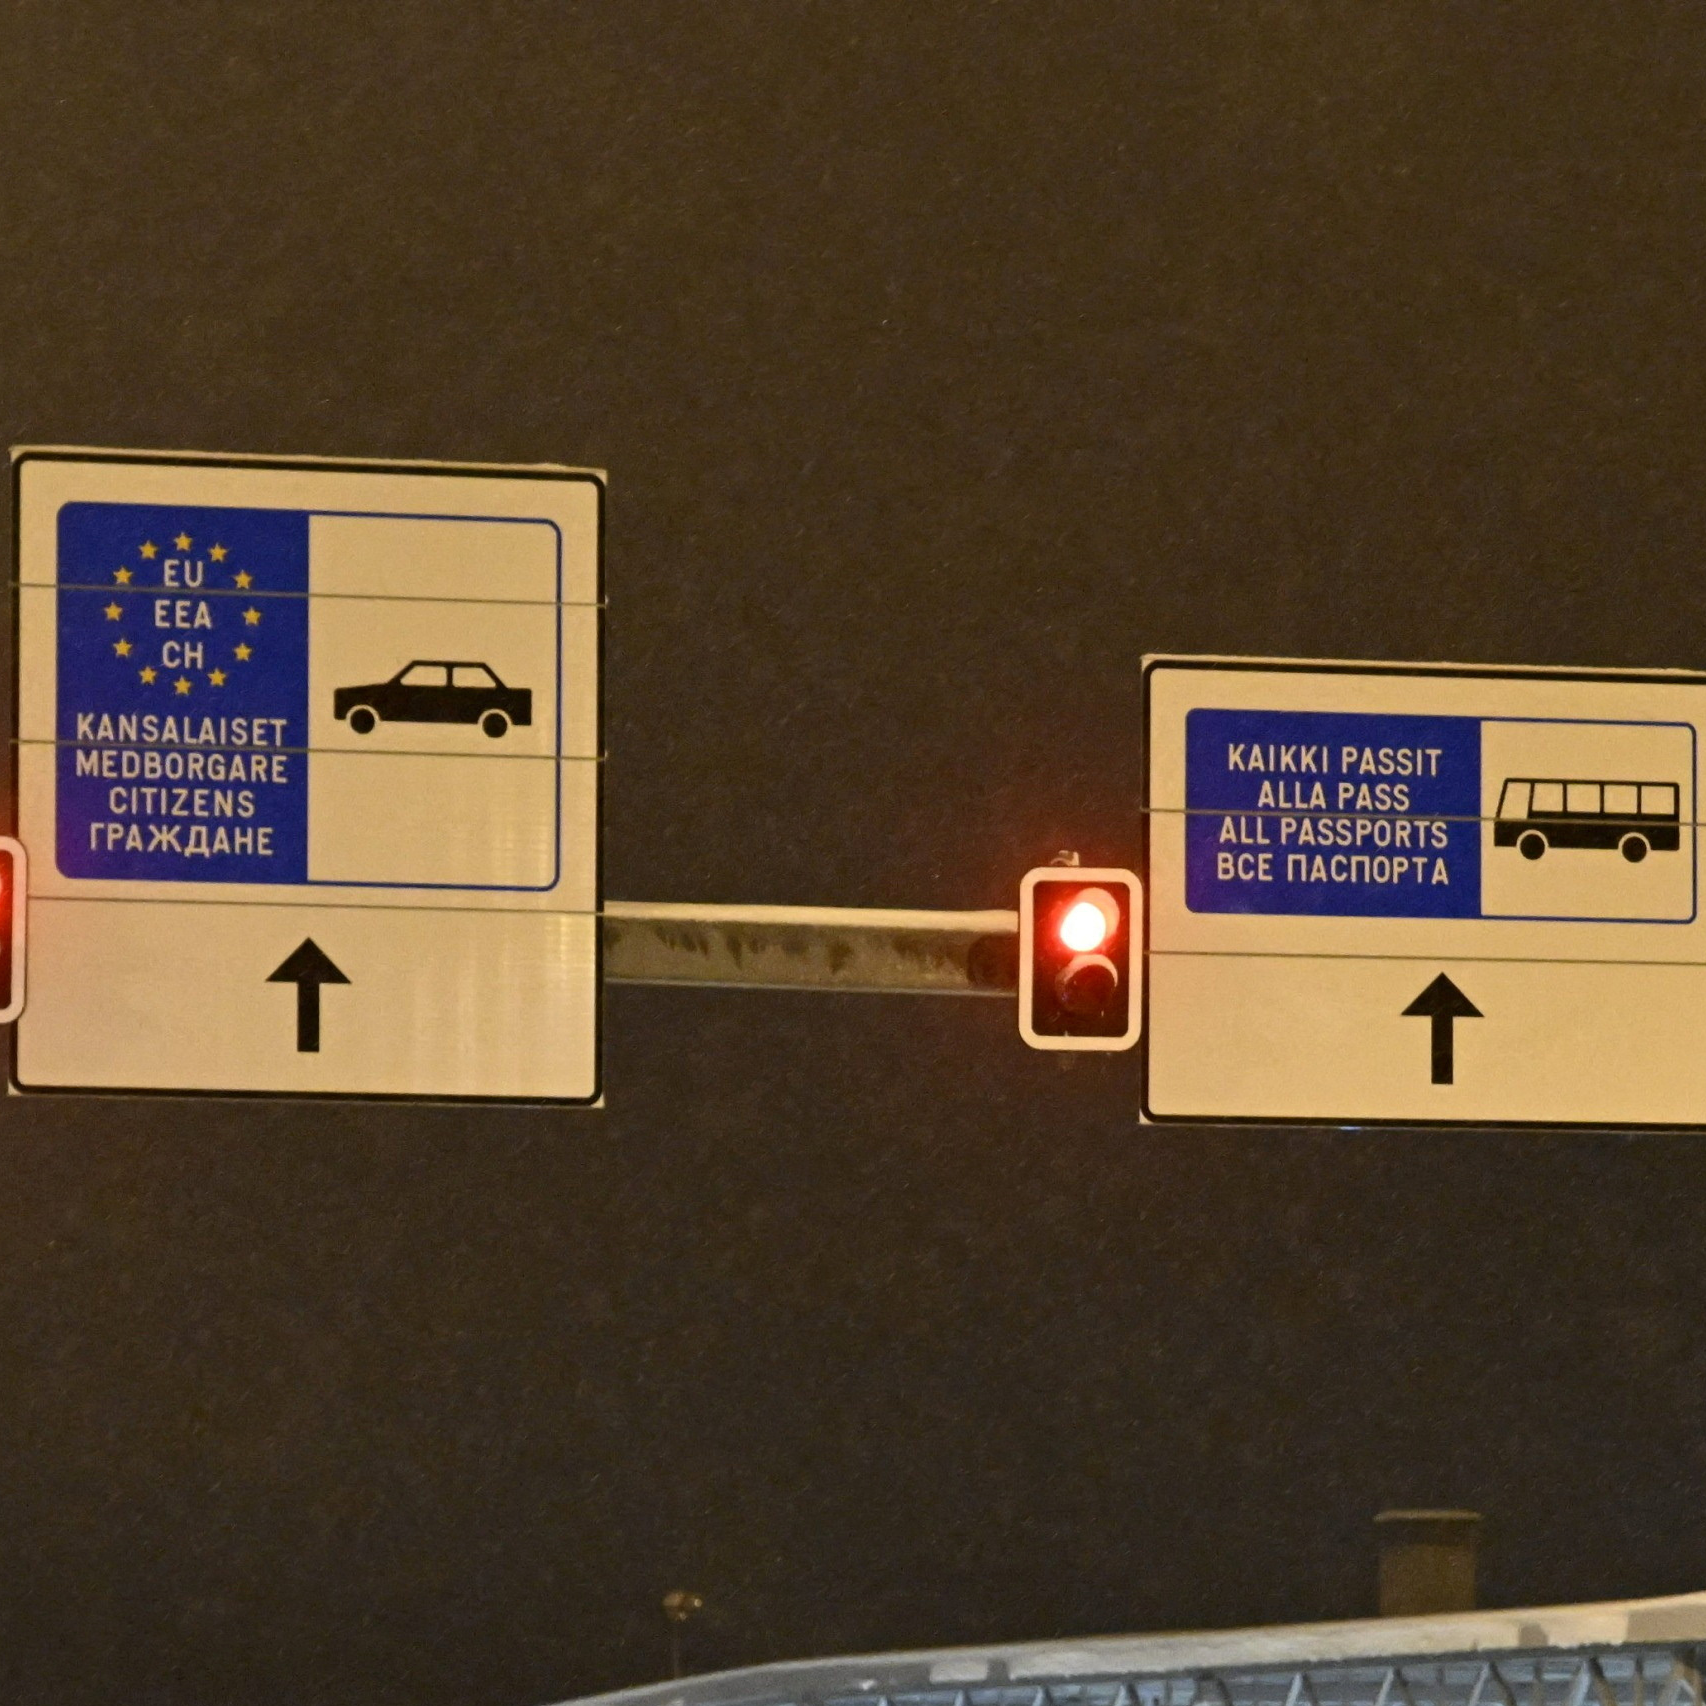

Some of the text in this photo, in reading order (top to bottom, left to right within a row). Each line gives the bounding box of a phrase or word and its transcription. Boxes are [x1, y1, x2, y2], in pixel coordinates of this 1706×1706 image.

[163, 559, 202, 587] EU
[154, 599, 211, 628] EEA
[162, 640, 203, 668] CH
[76, 712, 286, 746] KANSALAISET
[75, 748, 287, 783] MEDBORGARE
[1228, 743, 1441, 776] KAIKKI PASSIT
[109, 786, 254, 817] CITIZENS
[1257, 780, 1409, 811] ALLA PASS
[90, 822, 272, 857] ГРАЖДАНЕ
[1219, 816, 1447, 848] ALL PASSPORTS
[1217, 852, 1448, 884] ВСЕ ПАСПОРТА
